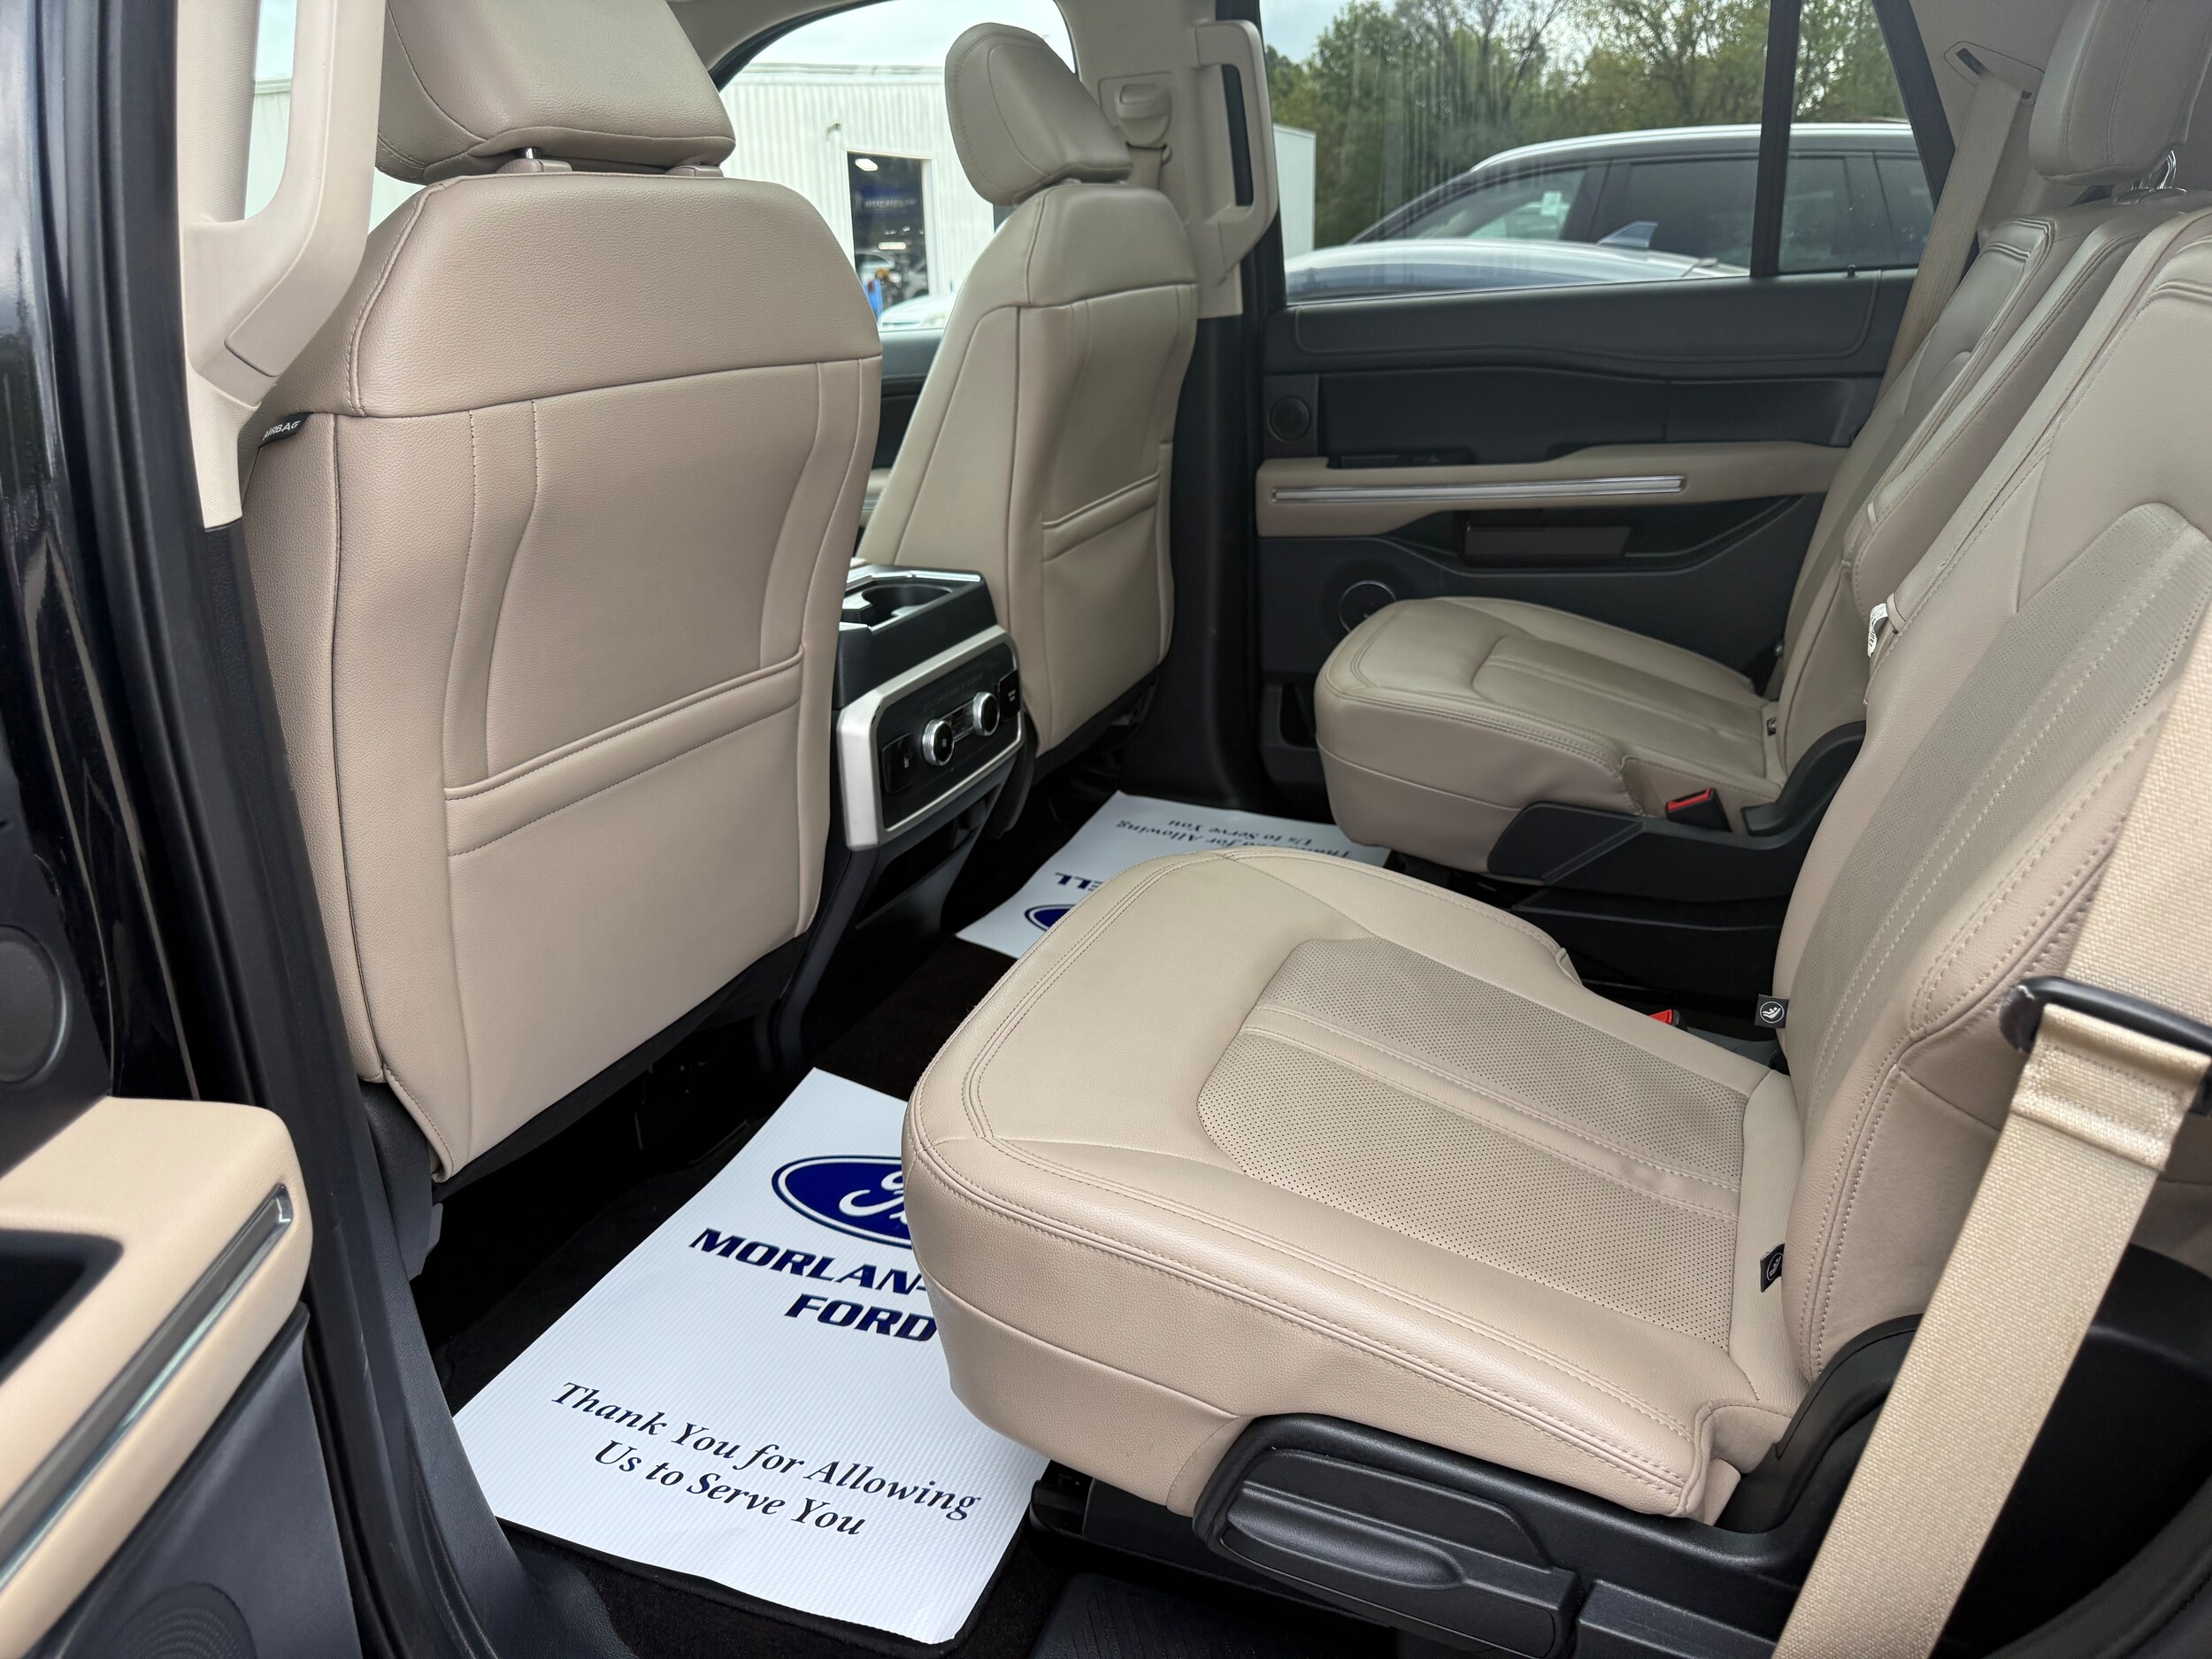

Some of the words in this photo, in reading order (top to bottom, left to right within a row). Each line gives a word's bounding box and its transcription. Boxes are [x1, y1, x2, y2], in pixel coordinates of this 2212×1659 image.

[262, 420, 301, 441] AIRBAG
[1117, 819, 1204, 841] Allowing
[1168, 819, 1202, 833] You
[1209, 827, 1259, 841] Serve
[1263, 833, 1282, 842] to
[784, 1293, 938, 1342] FORD
[551, 1382, 668, 1436] Thank
[671, 1422, 740, 1460] You
[735, 1443, 805, 1474] for
[803, 1460, 981, 1522] Allowing
[595, 1440, 642, 1472] Us
[645, 1463, 685, 1487] to
[686, 1471, 784, 1516] Serve
[790, 1497, 867, 1536] You
